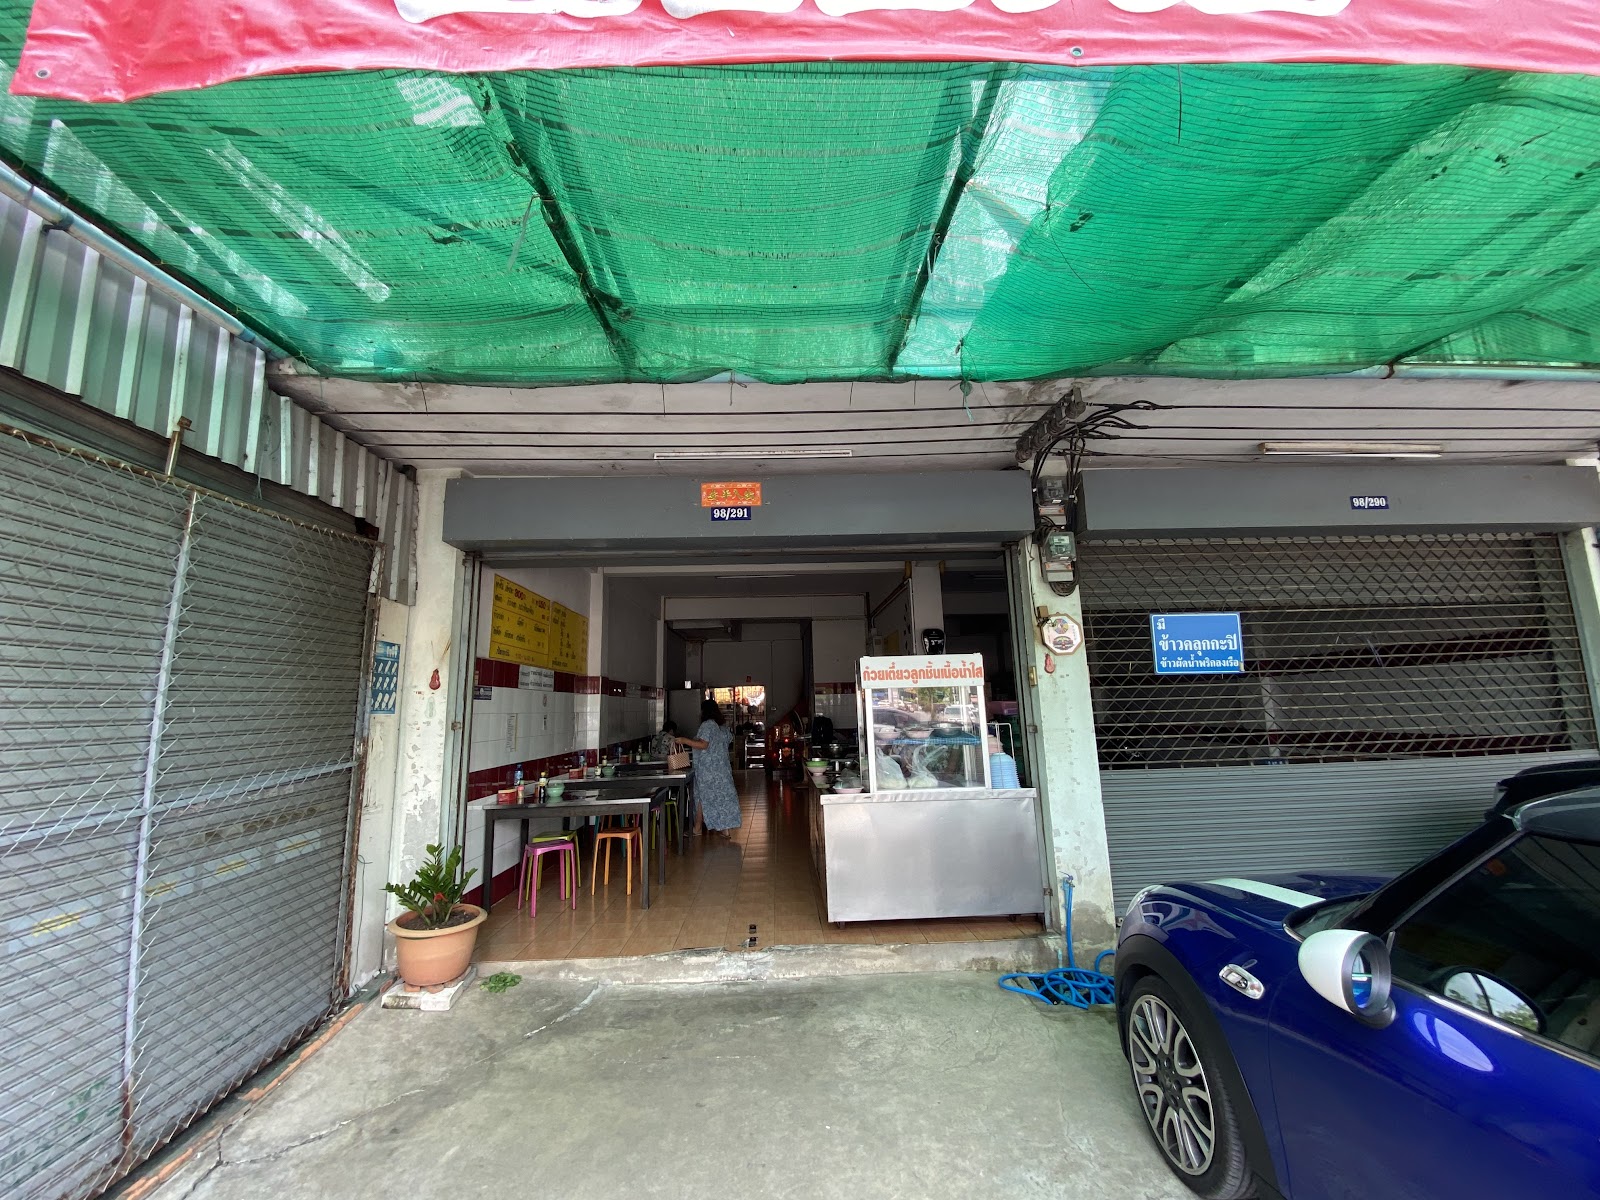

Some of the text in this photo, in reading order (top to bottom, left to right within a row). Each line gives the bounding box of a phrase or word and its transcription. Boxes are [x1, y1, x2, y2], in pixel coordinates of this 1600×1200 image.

[1353, 497, 1386, 508] 98/290
[714, 508, 748, 520] 98/291
[1157, 618, 1166, 630] มี
[1159, 633, 1238, 656] ข้าวคลุกกะปิ
[1160, 654, 1239, 668] ข้าวผัดน้ำพริกลงเรือ
